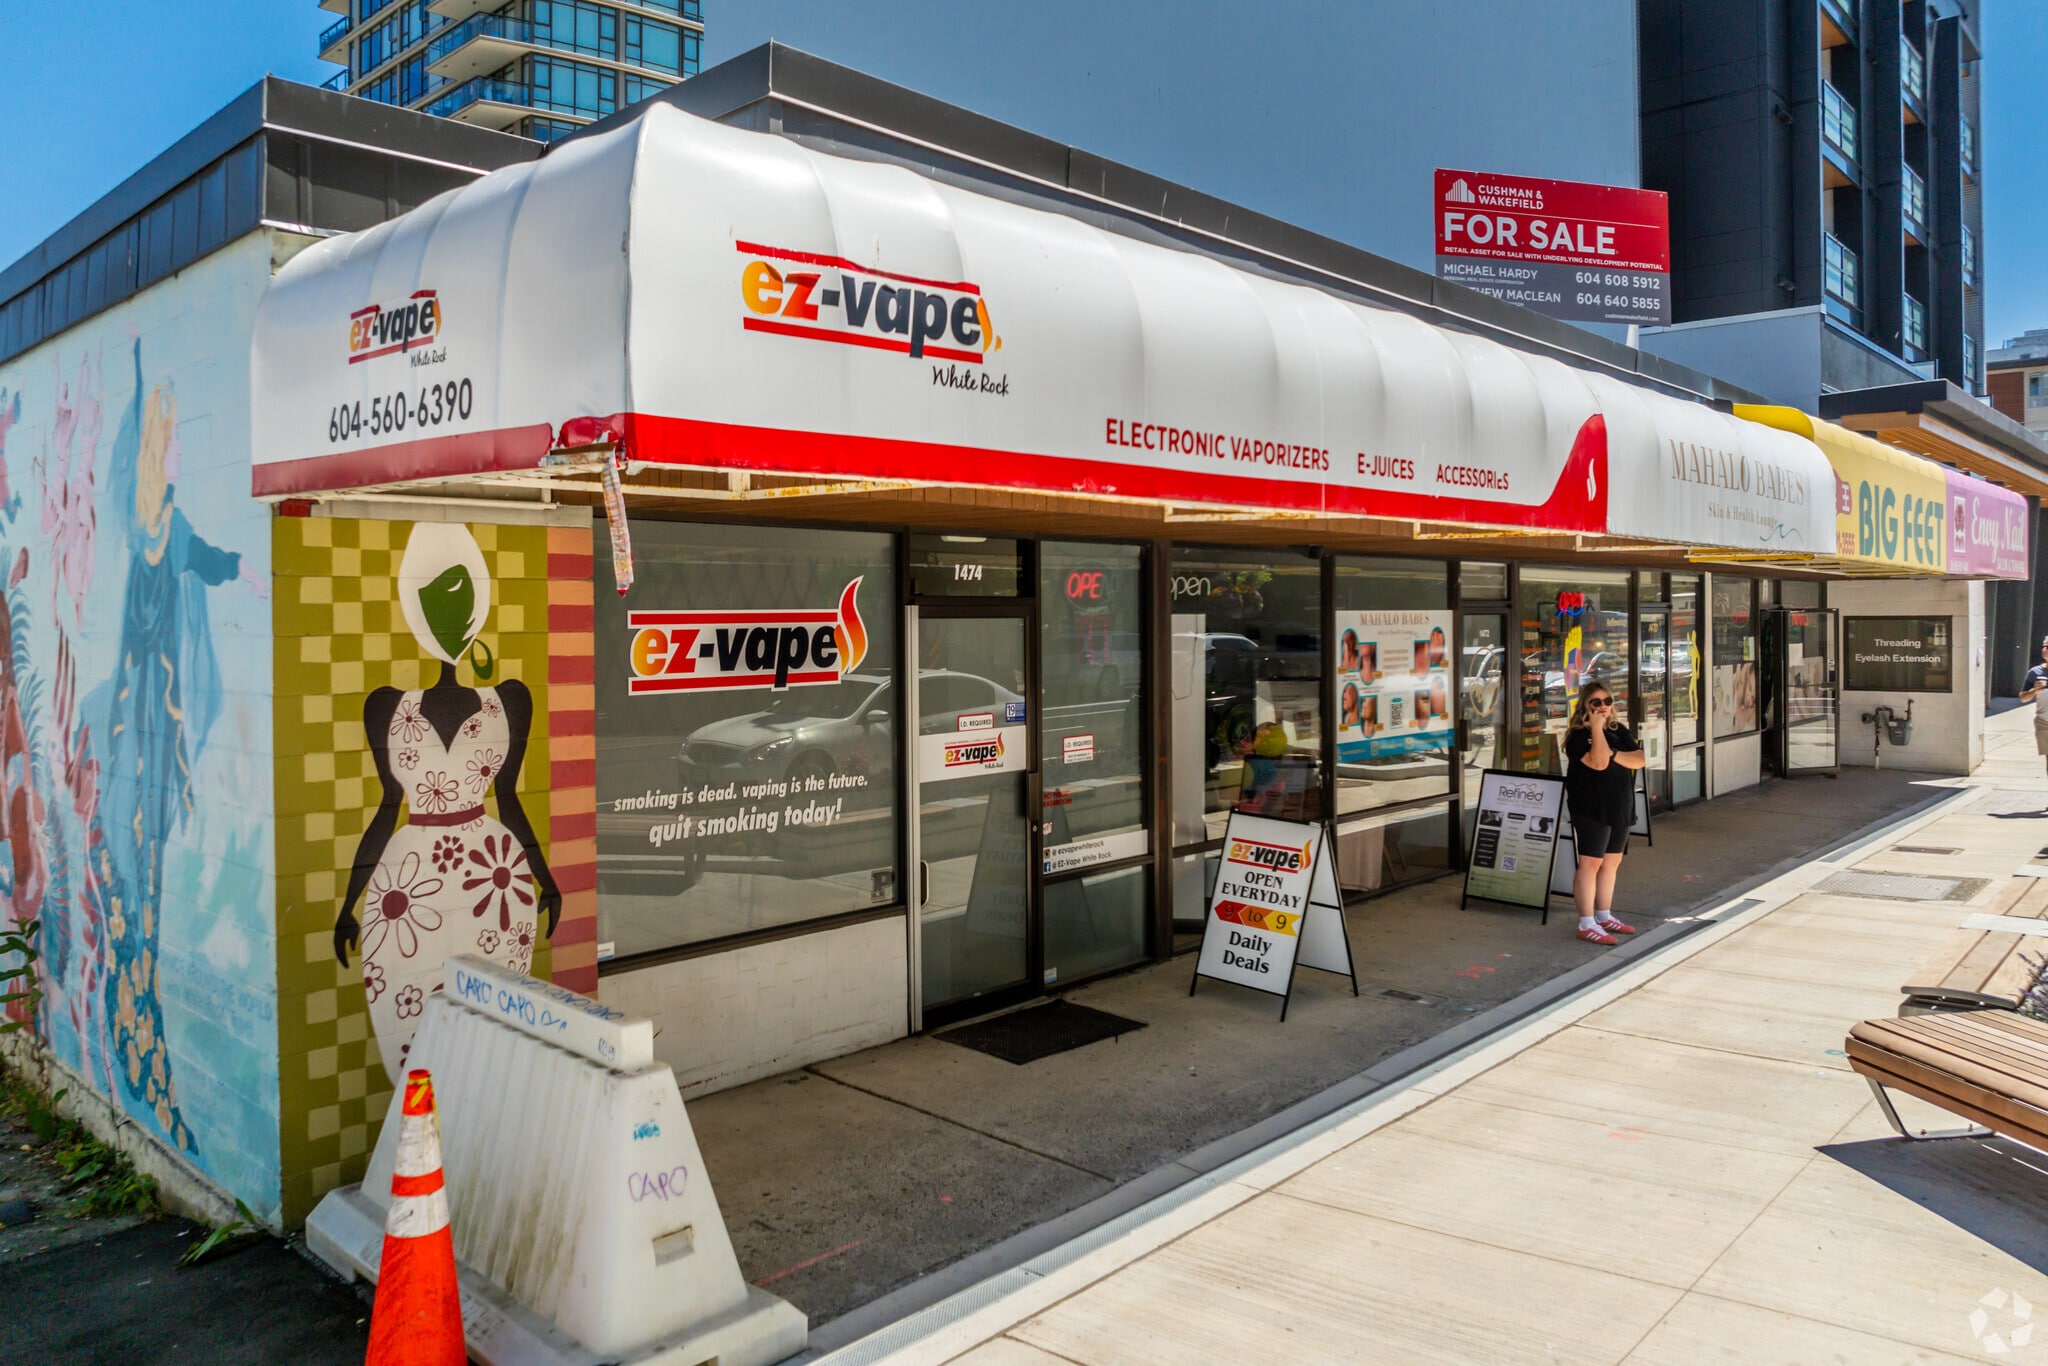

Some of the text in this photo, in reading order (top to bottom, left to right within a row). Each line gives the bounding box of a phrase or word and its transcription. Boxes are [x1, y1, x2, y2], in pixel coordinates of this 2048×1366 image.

[1478, 185, 1543, 200] CUSHMAN &
[1478, 195, 1544, 210] WAKEFIELD
[1444, 212, 1615, 256] FOR SALE
[1444, 246, 1469, 254] RETAIL
[1470, 248, 1490, 256] ASSET
[1524, 252, 1541, 260] WITH
[1543, 255, 1583, 263] UNDERLYING
[1584, 258, 1629, 267] DEVELOPMENT
[1630, 261, 1664, 270] POTENTIAL
[1444, 263, 1538, 280] MICHAEL HARDY
[1576, 272, 1660, 290] 604 608 5912
[1507, 289, 1561, 303] MACLEAN
[1576, 292, 1661, 310] 604 640 5855
[742, 260, 982, 359] ez-vape
[350, 299, 435, 353] ez-vape
[411, 346, 447, 368] White Rock
[933, 365, 1010, 397] White Rock
[329, 377, 473, 443] 604-560-6390
[1106, 418, 1225, 459] ELECTRONIC
[1231, 436, 1329, 471] VAPORIZERS
[1357, 453, 1414, 480] E-JUICES
[1669, 438, 1750, 493] MAHALO
[1754, 460, 1805, 505] BABES
[1708, 502, 1725, 519] Skin
[1733, 505, 1754, 523] Health
[1858, 480, 1944, 567] BIG FEET
[1971, 496, 1999, 564] Envy
[954, 564, 983, 581] 1474
[1360, 612, 1430, 626] MAHALO BABES
[1874, 638, 1921, 650] Threading
[633, 625, 838, 688] ez-vape
[1855, 653, 1941, 664] Eyelash Extension
[969, 718, 992, 727] REQUIRED
[1007, 704, 1015, 717] 19
[945, 745, 997, 764] ez-vape
[613, 772, 868, 813] smoking is dead. vaping is the future.
[1498, 785, 1544, 802] Refined
[649, 797, 842, 848] quit smoking today!
[1082, 853, 1097, 863] White
[1098, 851, 1112, 860] Rock
[1229, 842, 1300, 872] ez-vape
[1244, 871, 1284, 890] OPEN
[1221, 882, 1302, 909] EVERYDAY
[1224, 904, 1287, 930] 9 to 9
[1229, 930, 1272, 956] Daily
[1222, 949, 1270, 974] Deals
[497, 989, 536, 1027] CAPO
[627, 1165, 688, 1203] CAPO
